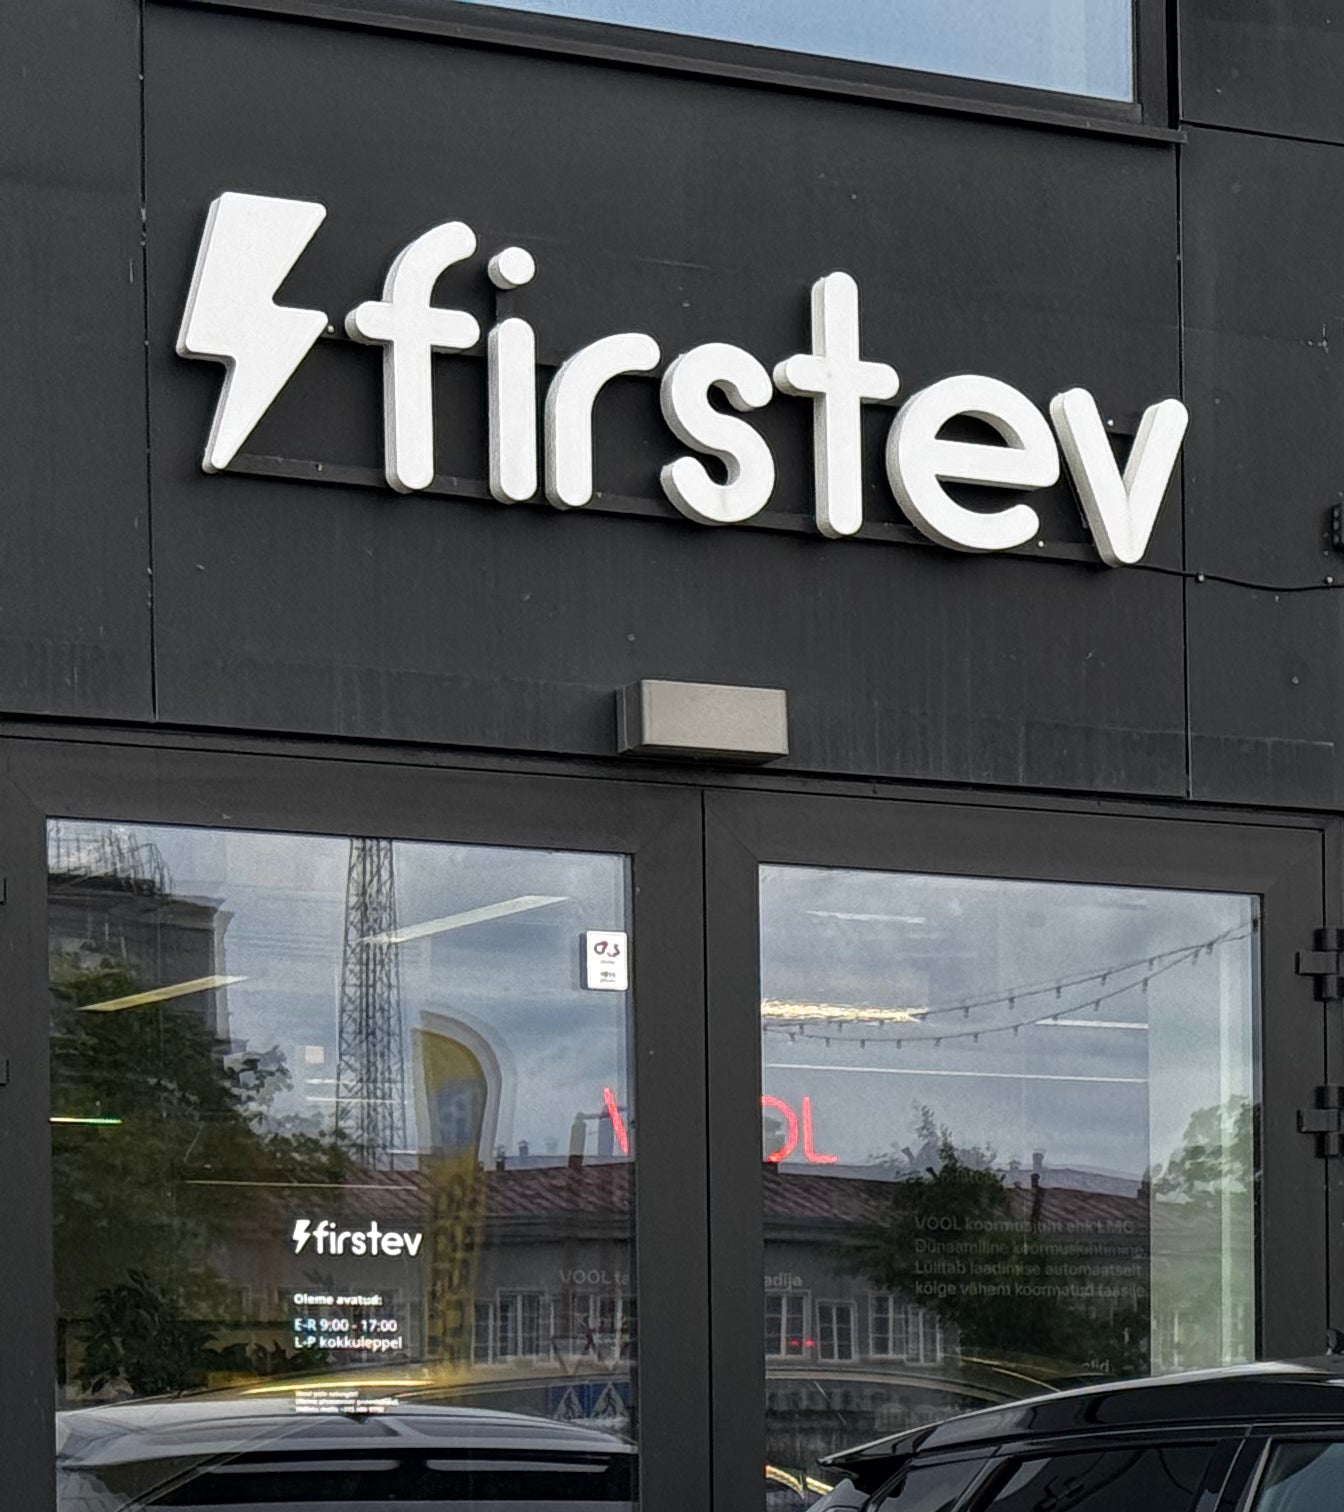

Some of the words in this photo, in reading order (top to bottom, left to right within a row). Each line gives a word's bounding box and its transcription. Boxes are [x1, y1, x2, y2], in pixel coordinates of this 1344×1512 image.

[344, 218, 1188, 568] firstev
[312, 1219, 423, 1257] firstev
[293, 1293, 335, 1305] Oleme
[294, 1317, 317, 1332] E-R
[320, 1318, 349, 1332] 9:00
[361, 1319, 397, 1333] 17:00
[320, 1336, 403, 1352] kokkuleppel
